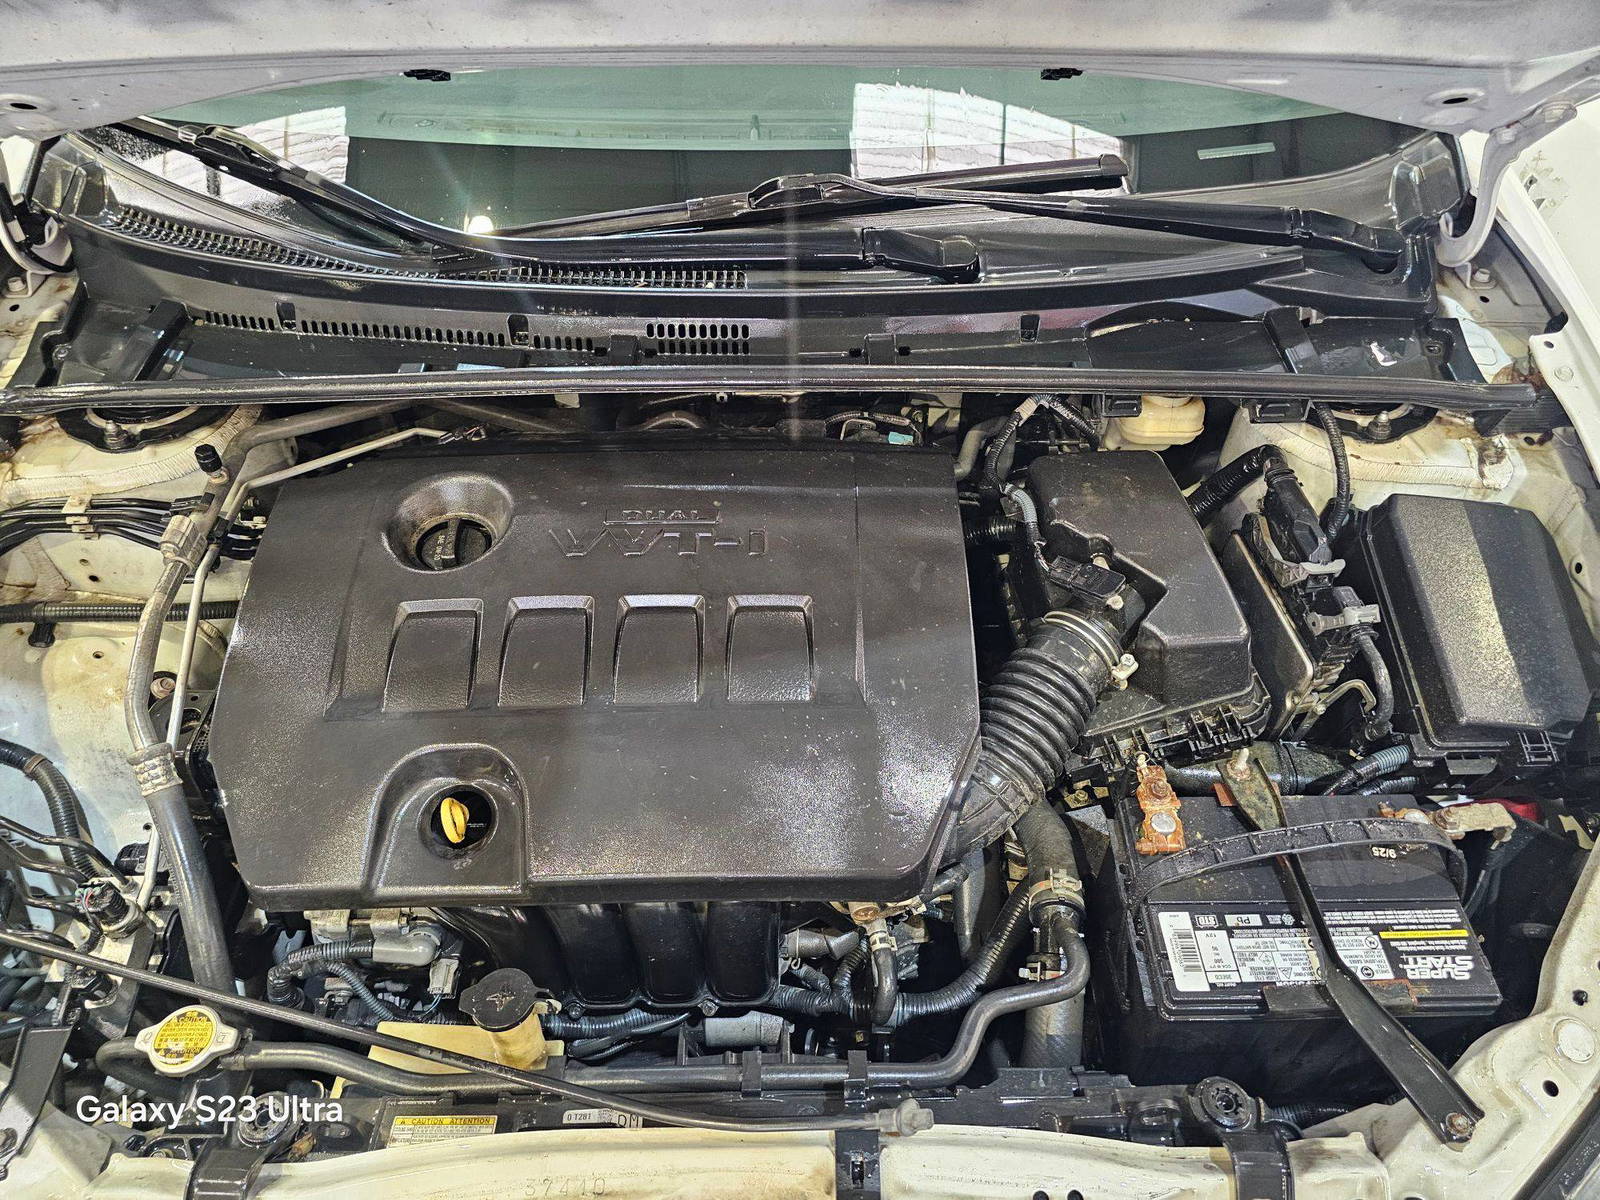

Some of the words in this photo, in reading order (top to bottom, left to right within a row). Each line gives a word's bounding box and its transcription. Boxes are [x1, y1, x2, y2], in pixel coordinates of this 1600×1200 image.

[621, 509, 709, 521] DUAL
[1236, 916, 1251, 924] Pb
[1406, 968, 1472, 981] SUPER
[411, 1117, 444, 1125] CAUTION
[450, 1117, 490, 1125] ATTENTION
